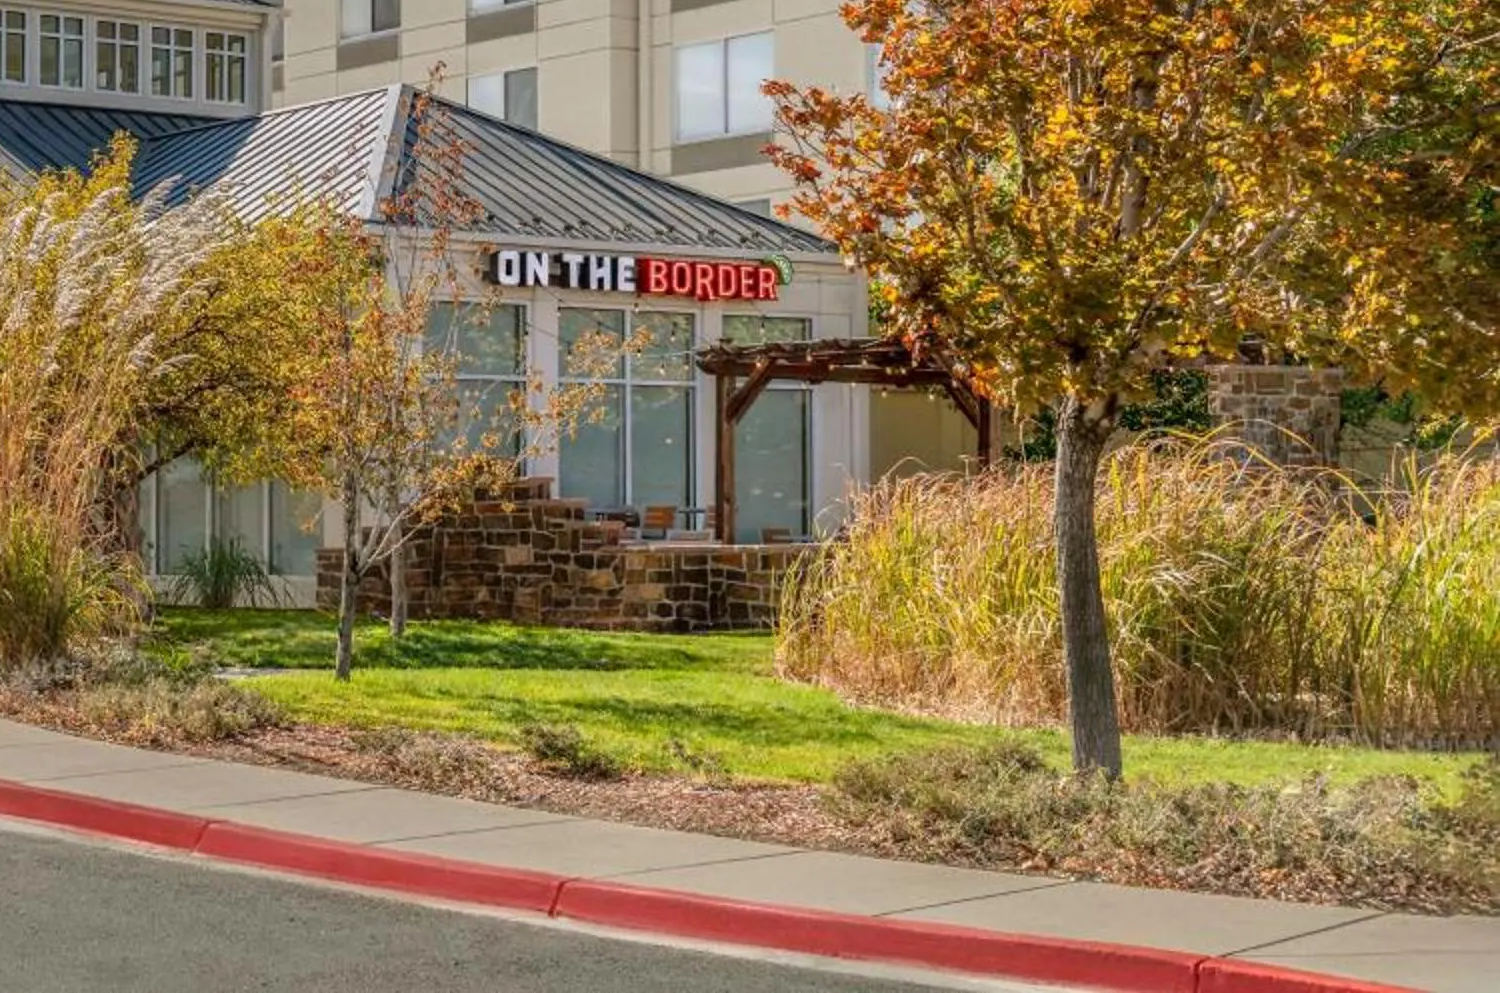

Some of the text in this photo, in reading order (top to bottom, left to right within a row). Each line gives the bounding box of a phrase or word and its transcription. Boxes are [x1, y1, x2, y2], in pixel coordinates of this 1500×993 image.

[497, 251, 779, 301] ON THE BORDER
